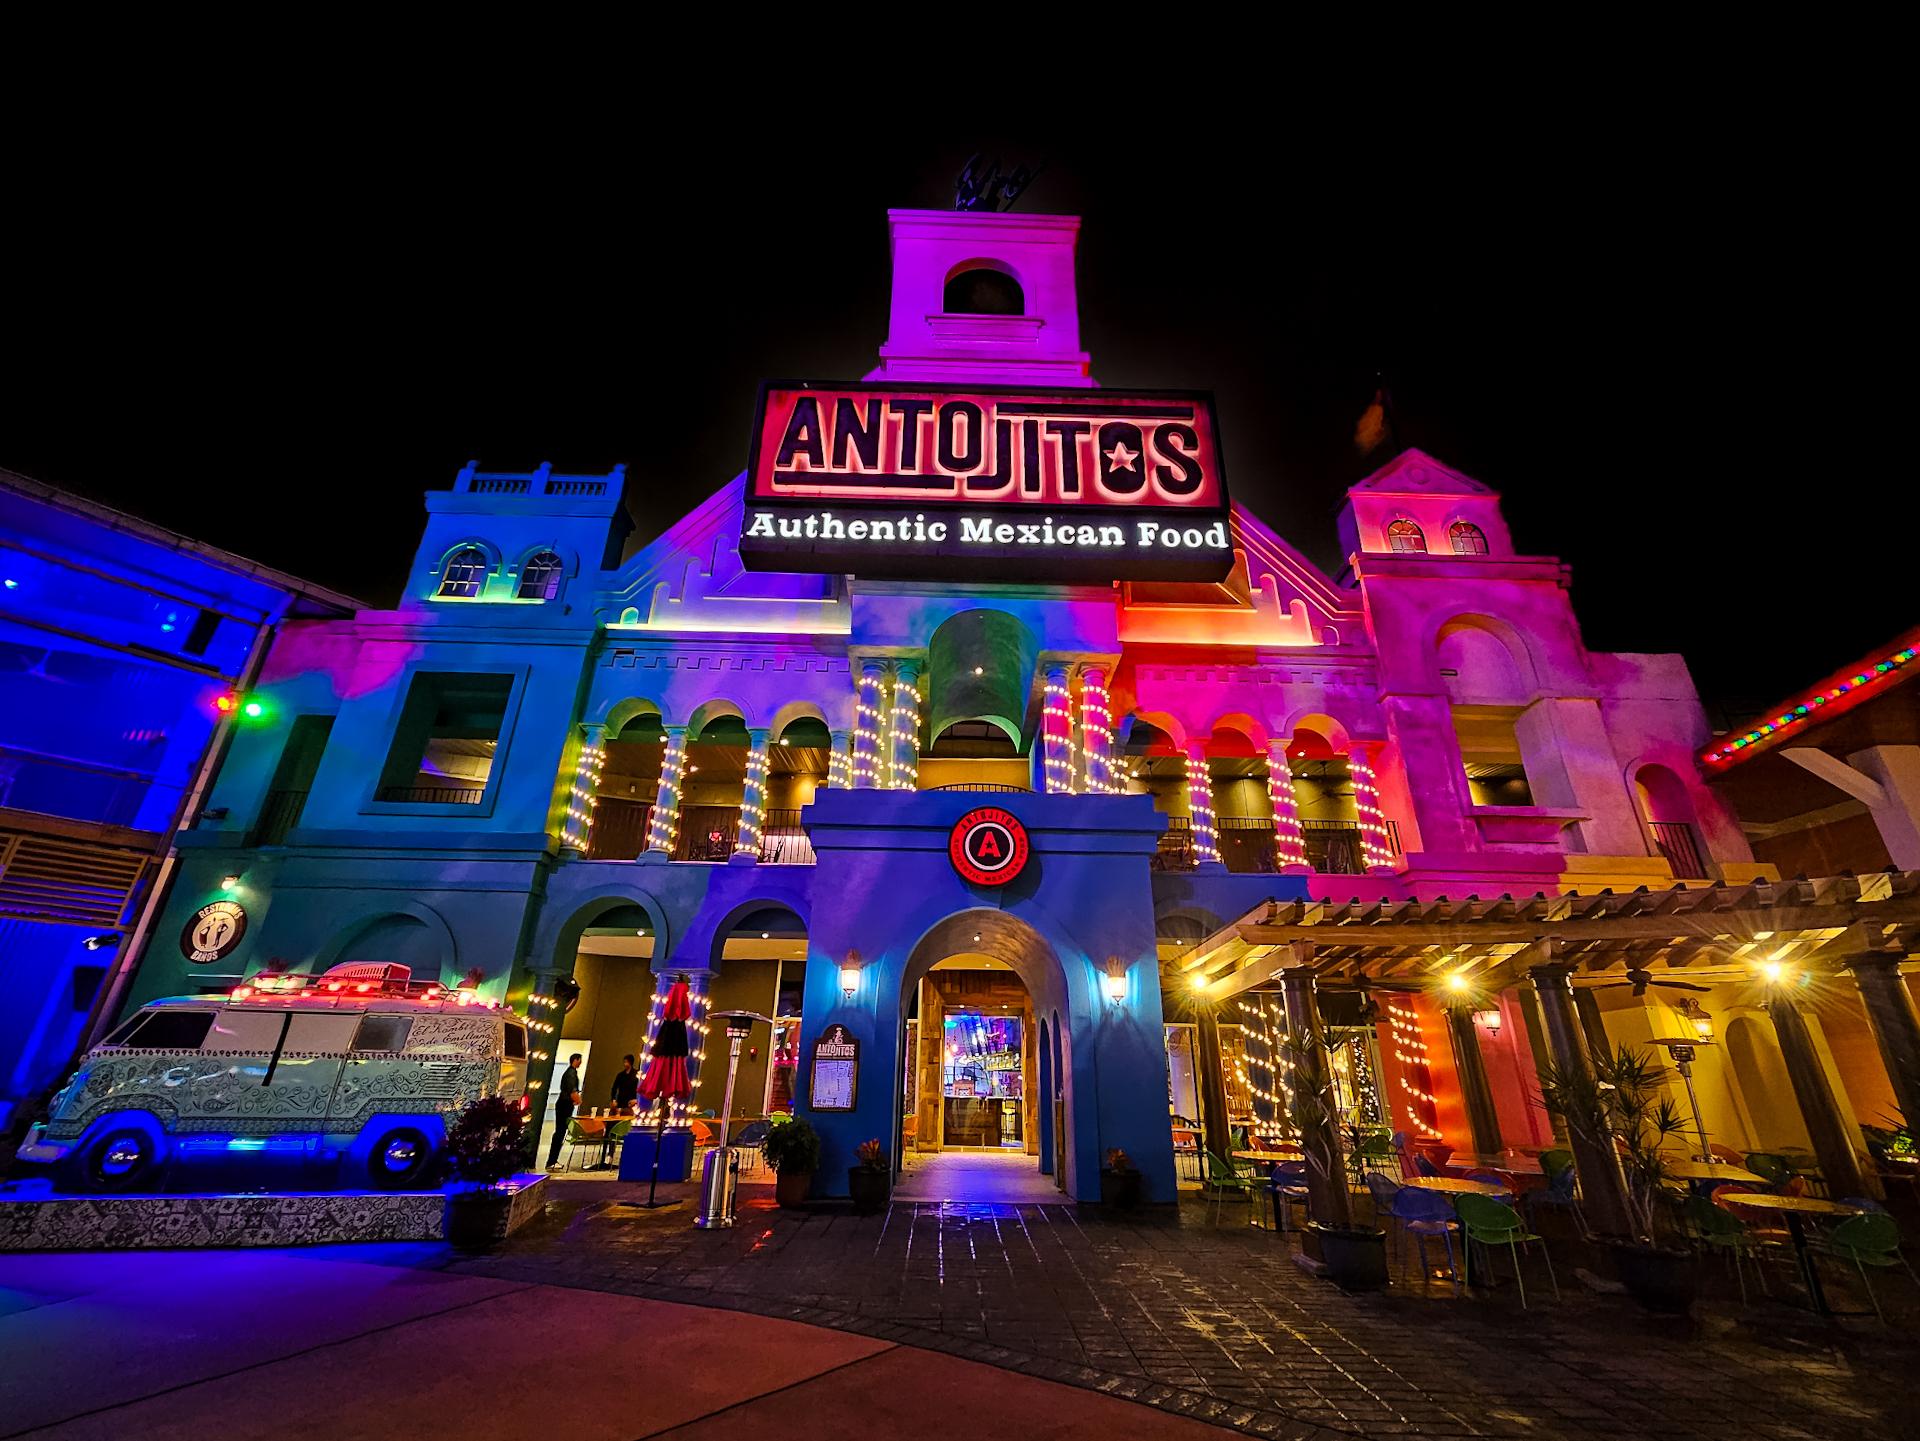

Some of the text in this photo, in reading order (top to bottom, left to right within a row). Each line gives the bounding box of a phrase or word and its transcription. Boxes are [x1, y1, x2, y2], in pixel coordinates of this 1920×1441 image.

[774, 396, 1203, 494] ANTOJITOS
[747, 513, 1229, 549] Authentic Mexican Food
[961, 811, 1018, 831] ANTOJITOS
[978, 831, 1001, 857] A
[816, 1044, 855, 1056] ANTOJITOS
